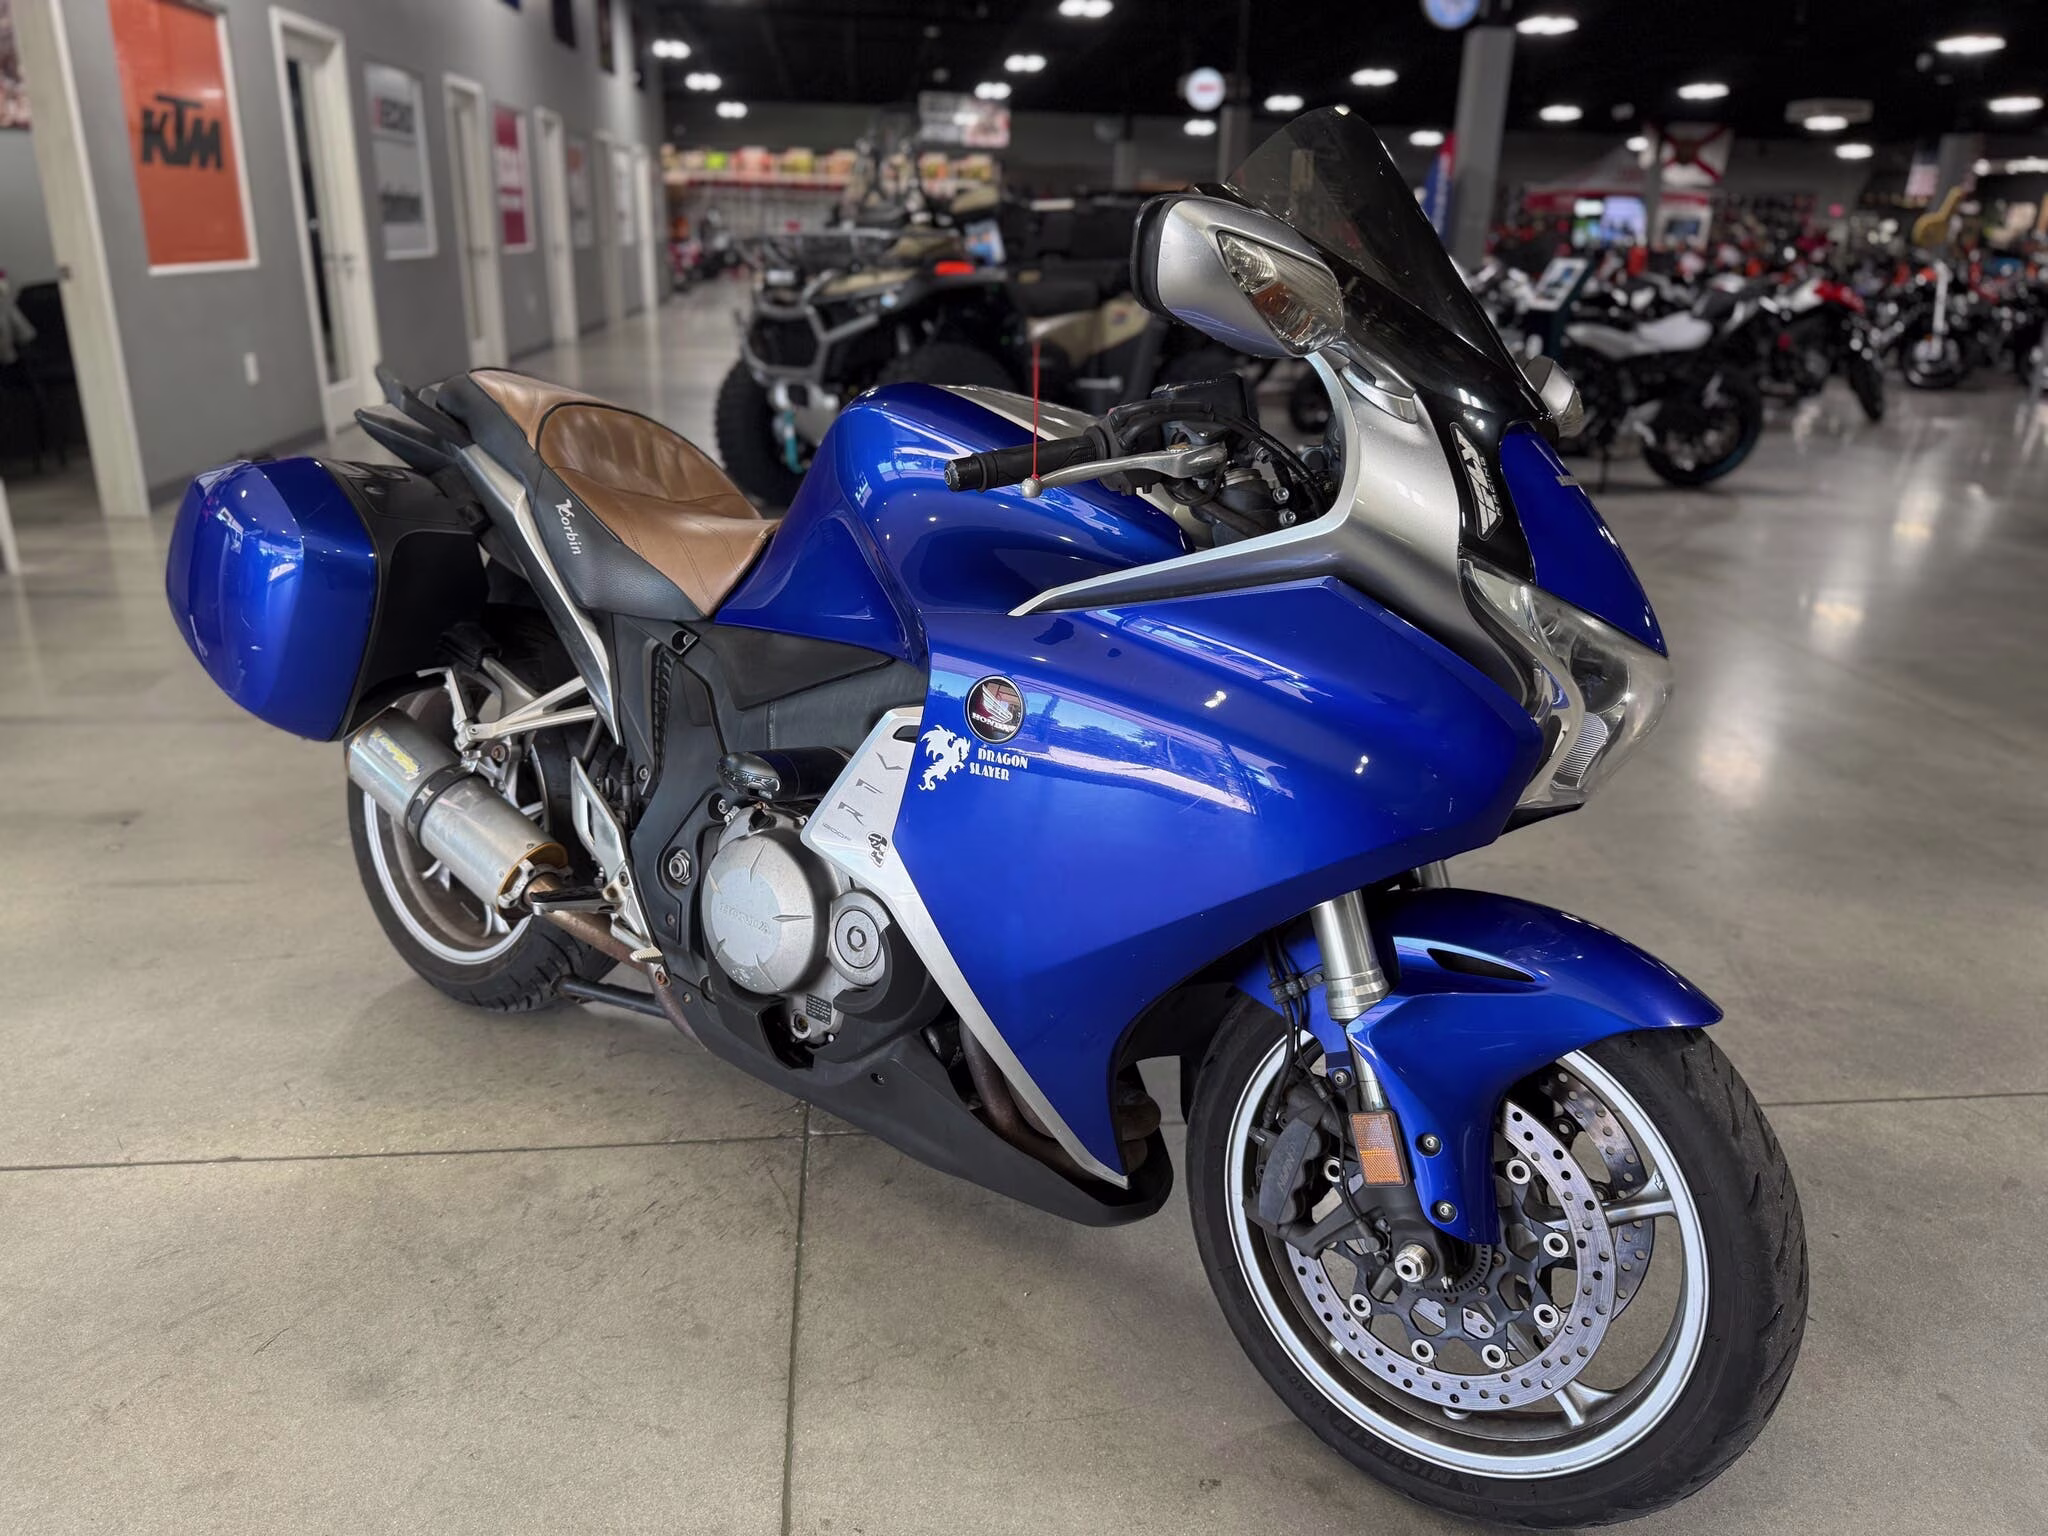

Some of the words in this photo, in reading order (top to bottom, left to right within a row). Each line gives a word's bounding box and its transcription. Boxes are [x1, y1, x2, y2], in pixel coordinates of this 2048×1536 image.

[142, 92, 223, 171] KTM
[971, 712, 1017, 733] HONDA
[978, 748, 1028, 769] DRAGON
[969, 762, 1009, 781] SLAYER
[1332, 1416, 1451, 1484] MICHELIN
